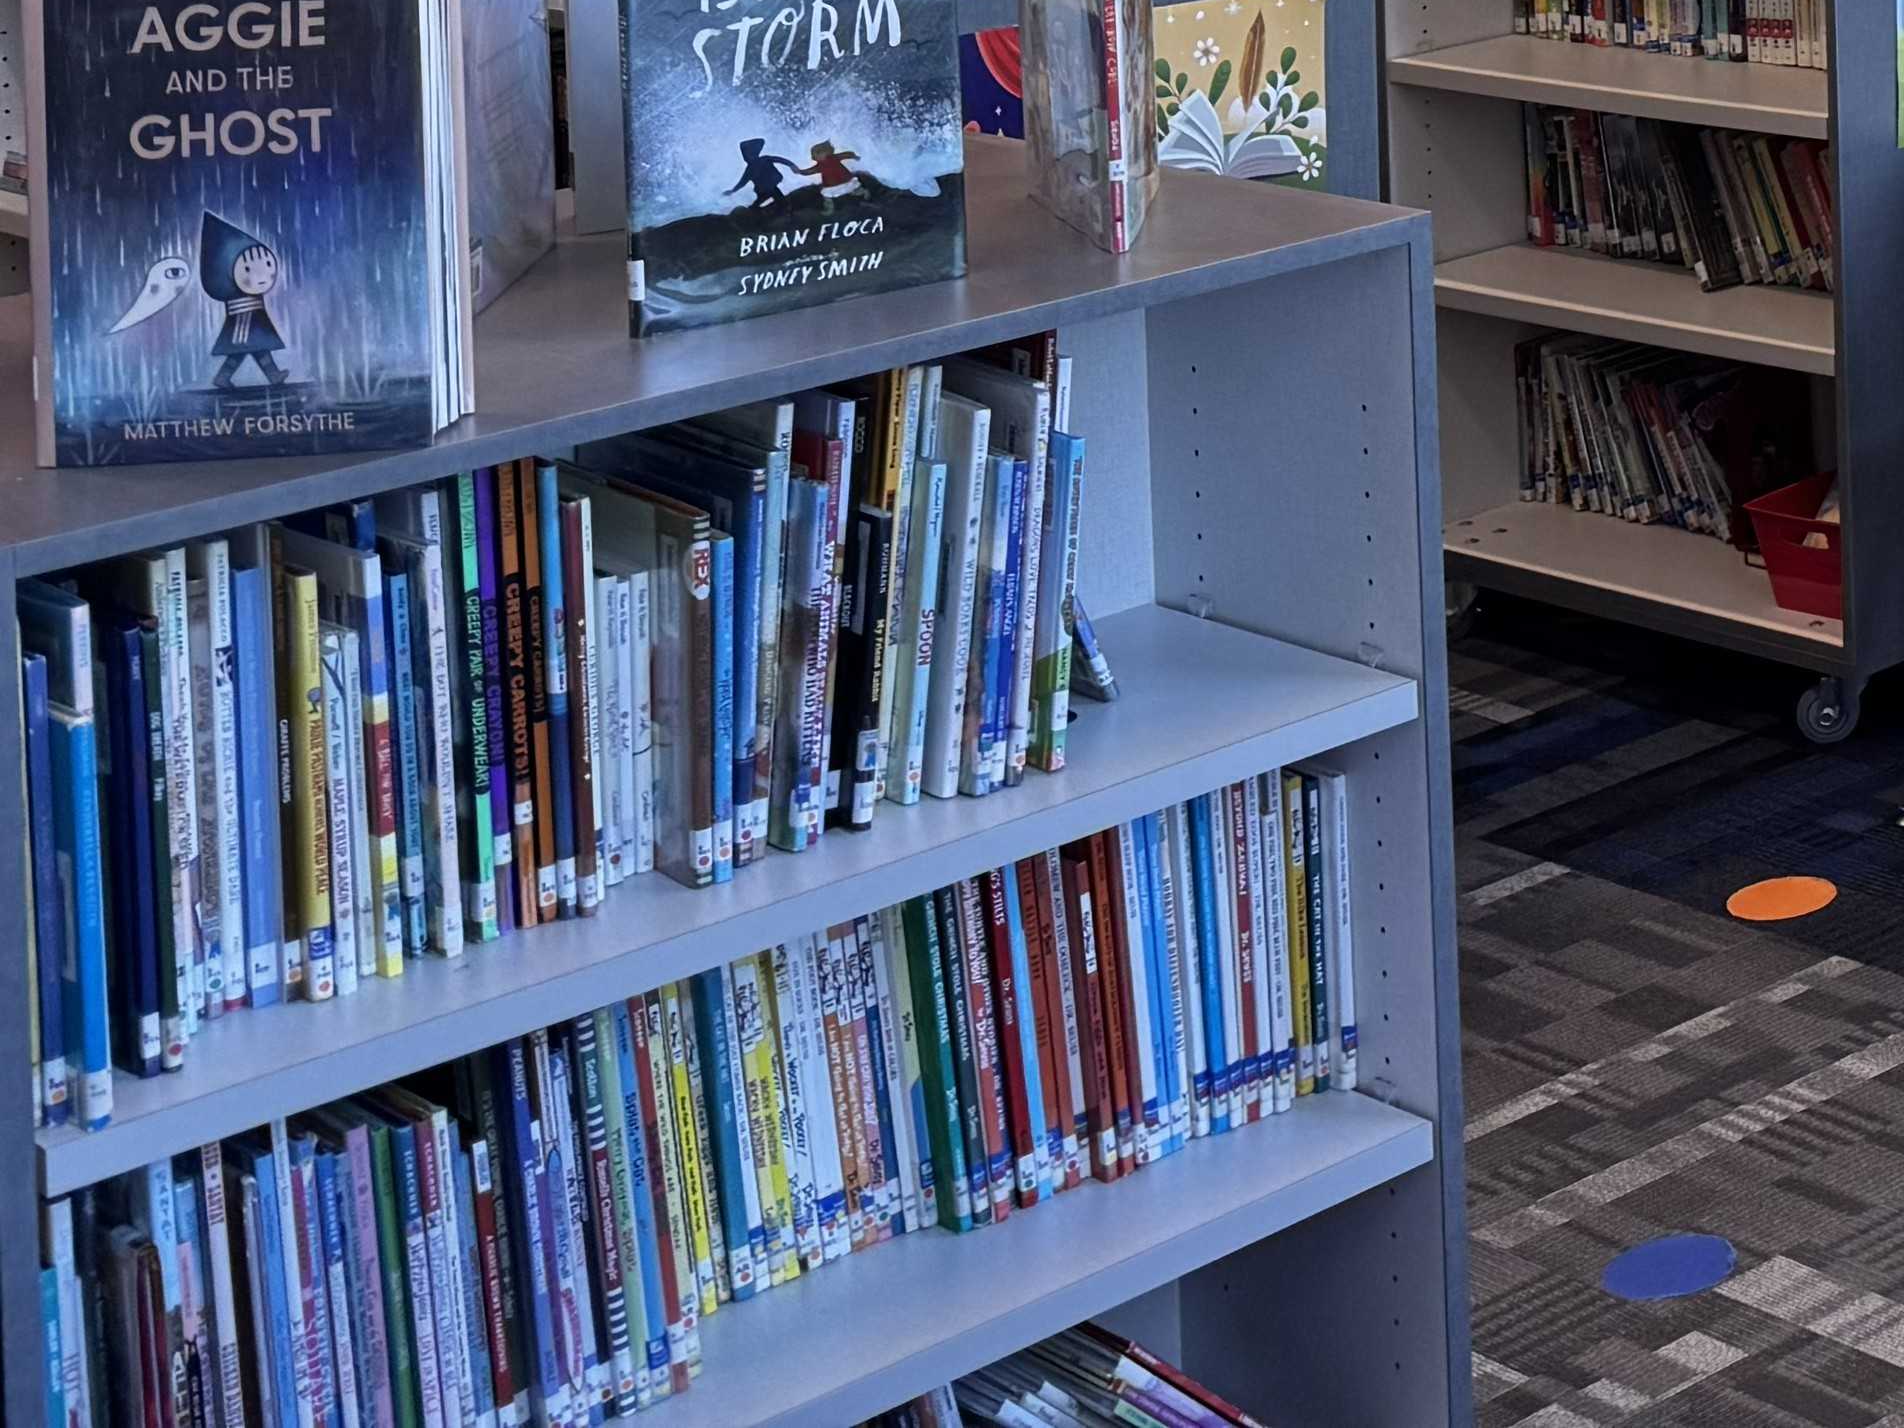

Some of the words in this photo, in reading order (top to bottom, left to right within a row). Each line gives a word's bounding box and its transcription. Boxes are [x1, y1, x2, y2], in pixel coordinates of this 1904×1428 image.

[130, 0, 326, 54] AGGIE
[165, 67, 227, 95] AND
[236, 65, 294, 90] THE
[129, 107, 333, 161] GHOST
[739, 227, 810, 258] BRIAN
[817, 216, 884, 242] FLOCA
[738, 265, 815, 296] SYDNEY
[817, 250, 884, 281] SMITH
[124, 417, 235, 441] MATTHEW
[244, 411, 355, 436] FORSYTHE
[693, 548, 710, 590] REX
[821, 540, 838, 596] WHAT
[465, 595, 484, 645] CREEPY
[482, 604, 500, 681] CREEPY
[506, 582, 525, 671] CREEPY
[529, 595, 543, 647] CREEPY
[815, 600, 831, 668] ANIMALS
[917, 608, 936, 667] SPOON
[468, 648, 484, 678] PAIR
[278, 719, 291, 755] GIRAFFE
[470, 697, 491, 789] UNDERWEAR!
[486, 685, 506, 763] CRAYON!
[511, 674, 530, 776] CARROTS!
[280, 757, 293, 804] PROBLEMS
[330, 777, 347, 816] MAPLE
[332, 819, 349, 857] SYRUP
[334, 859, 351, 905] SEASON
[924, 901, 939, 943] GRINCH
[992, 891, 1005, 926] STILTS
[928, 945, 943, 977] STOLE
[945, 919, 958, 959] GRINCH
[949, 963, 963, 995] STOLE
[1314, 961, 1325, 985] HAT
[933, 982, 950, 1044] CHRISTMAS
[954, 999, 971, 1061] CHRISTMAS
[511, 1047, 526, 1101] PEANUTS
[585, 1059, 597, 1099] Scotton
[748, 1078, 762, 1112] WACKY
[759, 1075, 773, 1111] WACKY
[624, 1093, 642, 1136] Splat
[403, 1150, 418, 1215] SCHACHNER
[423, 1141, 438, 1209] SCHACHNER
[599, 1197, 615, 1249] Christmas
[605, 1250, 619, 1281] Magic
